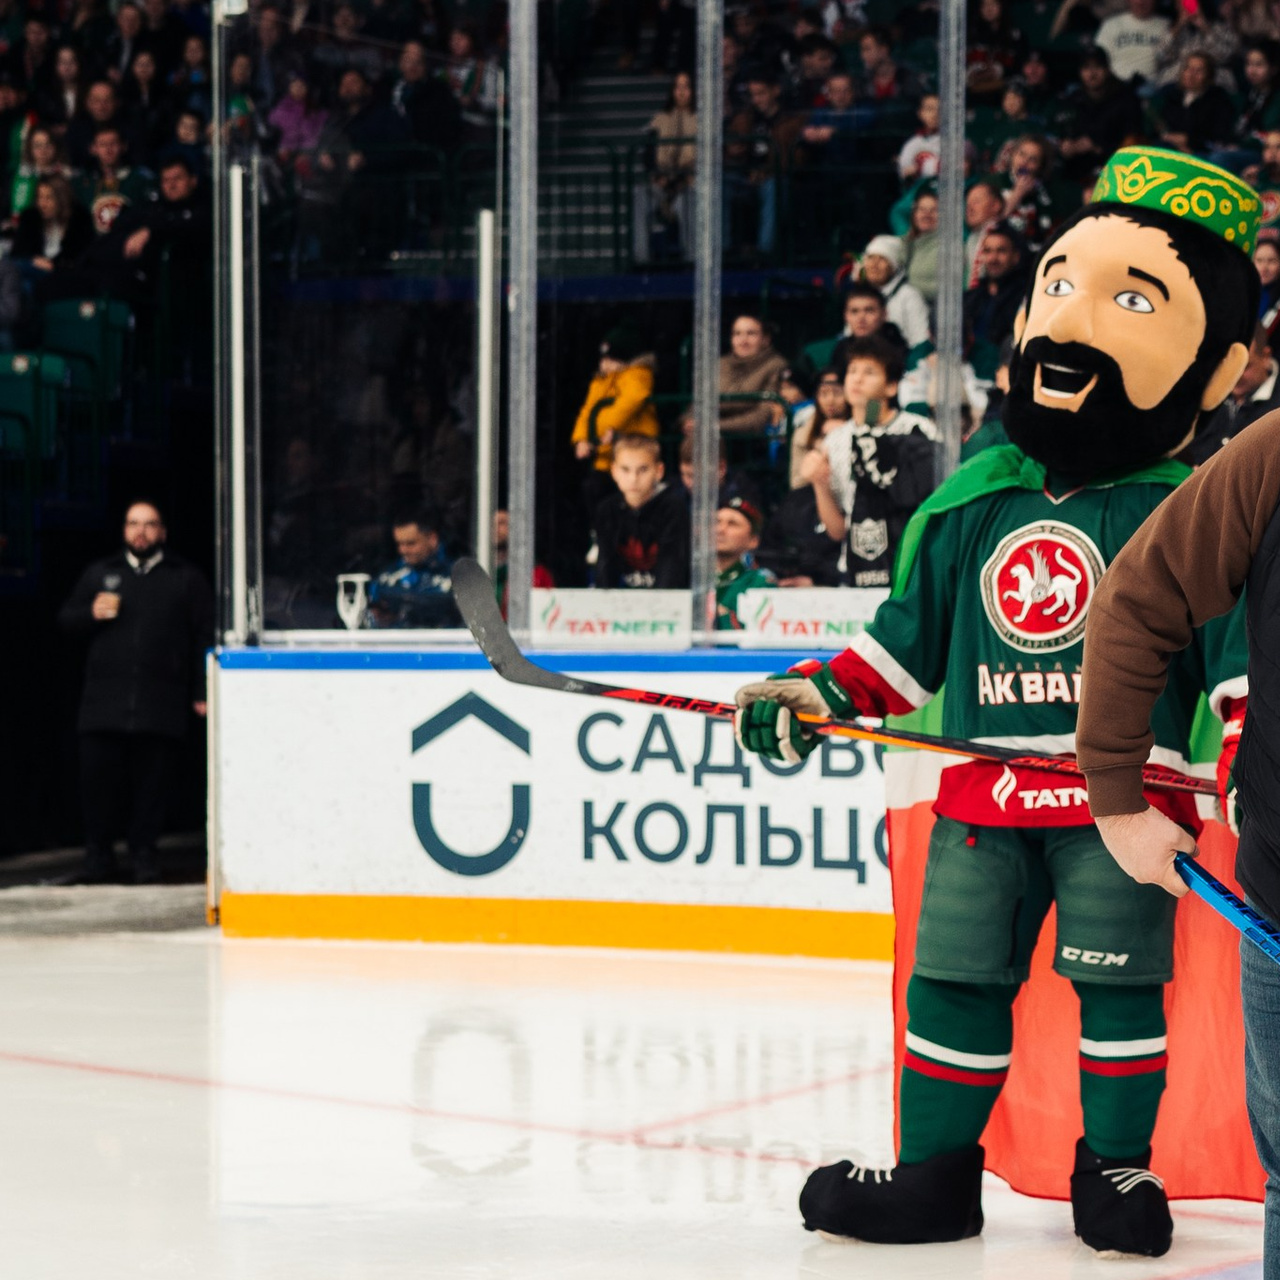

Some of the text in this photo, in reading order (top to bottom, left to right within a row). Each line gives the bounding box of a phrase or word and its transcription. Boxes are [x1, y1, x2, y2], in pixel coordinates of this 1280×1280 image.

[855, 570, 890, 586] 1956
[566, 619, 680, 636] TATNEFT
[577, 711, 886, 788] САДВ
[1018, 787, 1089, 810] TATN
[1061, 945, 1130, 967] CCM
